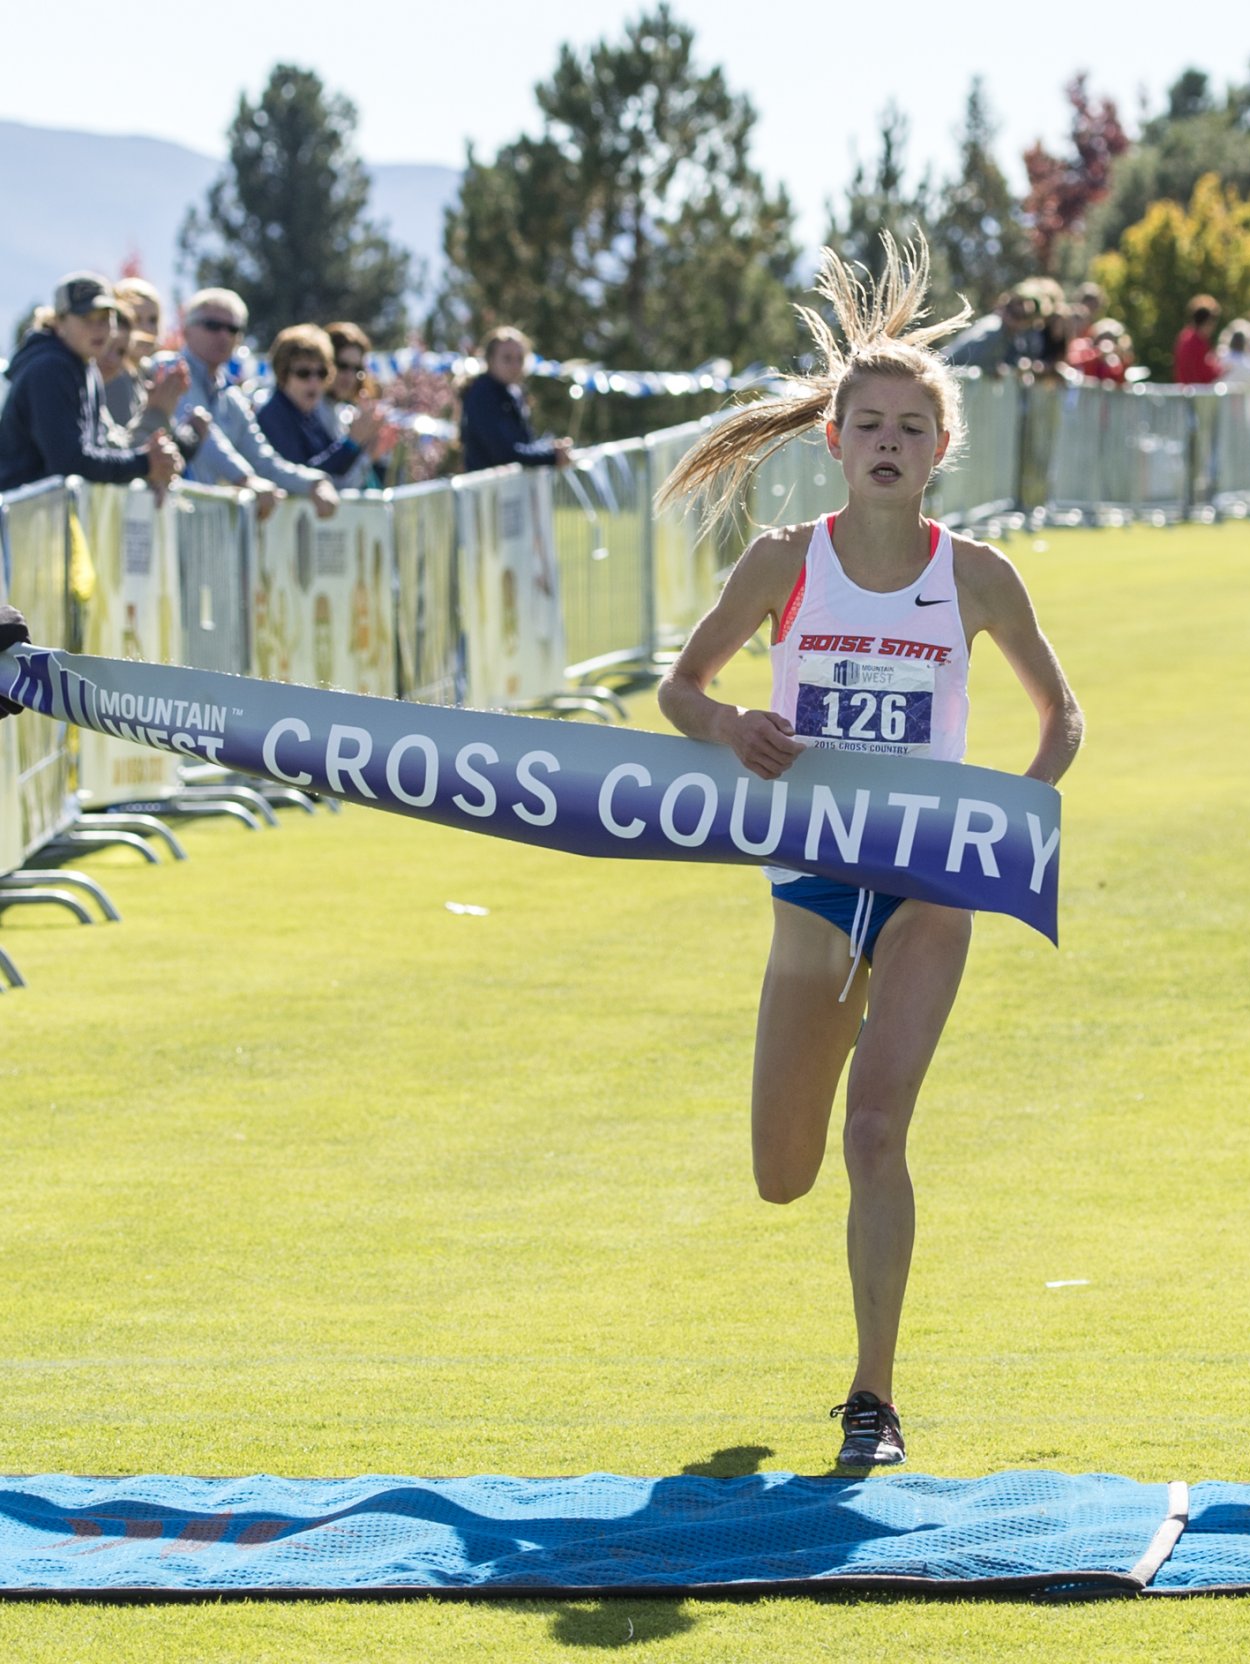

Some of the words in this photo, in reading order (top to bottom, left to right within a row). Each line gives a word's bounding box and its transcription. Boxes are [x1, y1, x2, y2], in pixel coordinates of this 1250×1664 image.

[799, 635, 875, 653] BOISE
[878, 638, 952, 663] STATE
[862, 664, 894, 673] MOUNTAIN
[862, 672, 894, 684] WEST
[100, 689, 227, 733] MOUNTAIN
[821, 691, 907, 740] 126
[814, 740, 836, 750] 2015
[838, 743, 867, 752] CROSS
[869, 745, 909, 755] COUNTRY
[262, 717, 560, 827] CROSS
[598, 763, 1060, 895] COUNTRY
